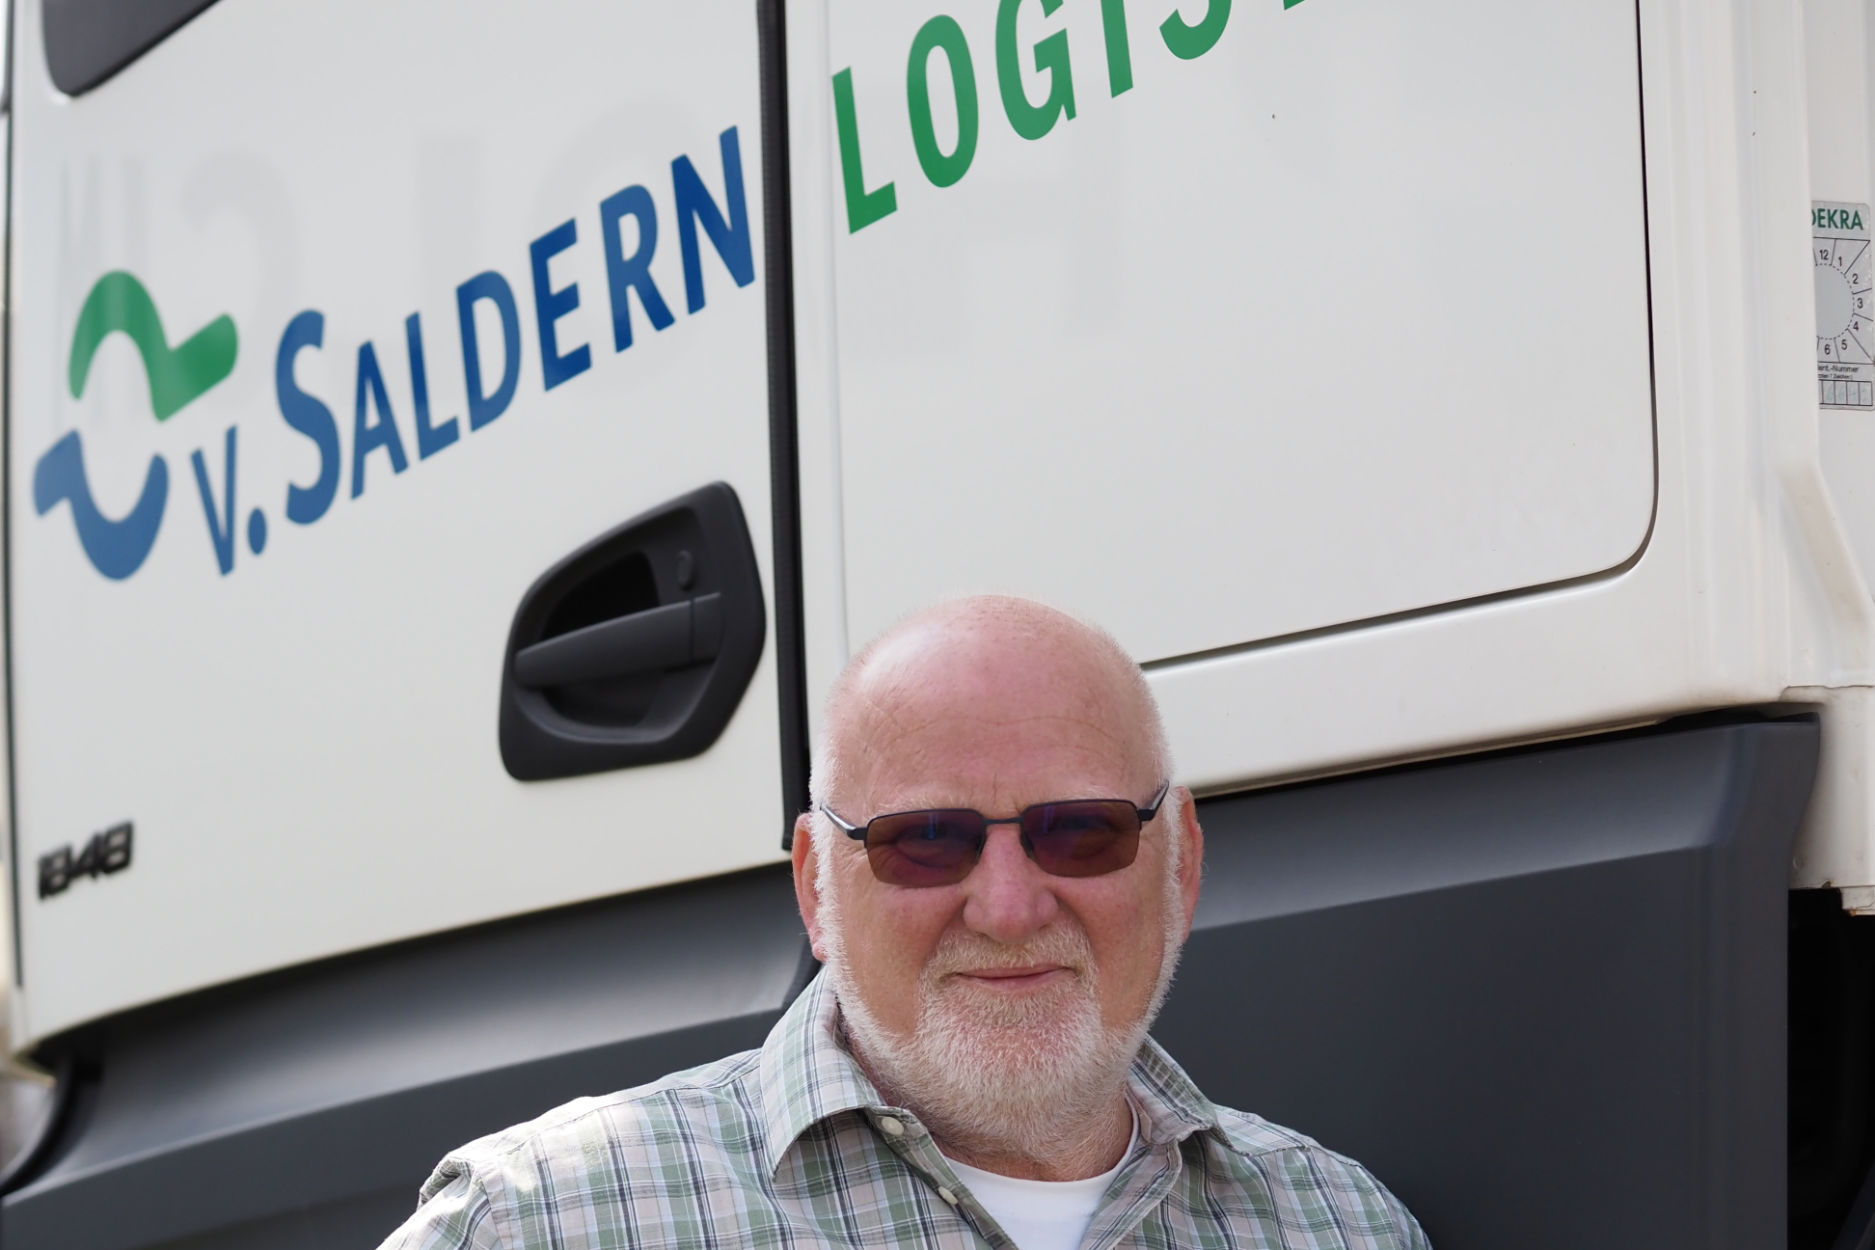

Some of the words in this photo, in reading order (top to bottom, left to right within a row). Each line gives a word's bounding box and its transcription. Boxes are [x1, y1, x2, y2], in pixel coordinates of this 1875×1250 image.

[1819, 249, 1829, 260] 12
[1838, 256, 1843, 267] 1
[1852, 273, 1859, 285] 2
[1857, 297, 1864, 309] 3
[1853, 320, 1860, 331] 4
[1824, 343, 1831, 355] 6
[1841, 338, 1848, 351] 5
